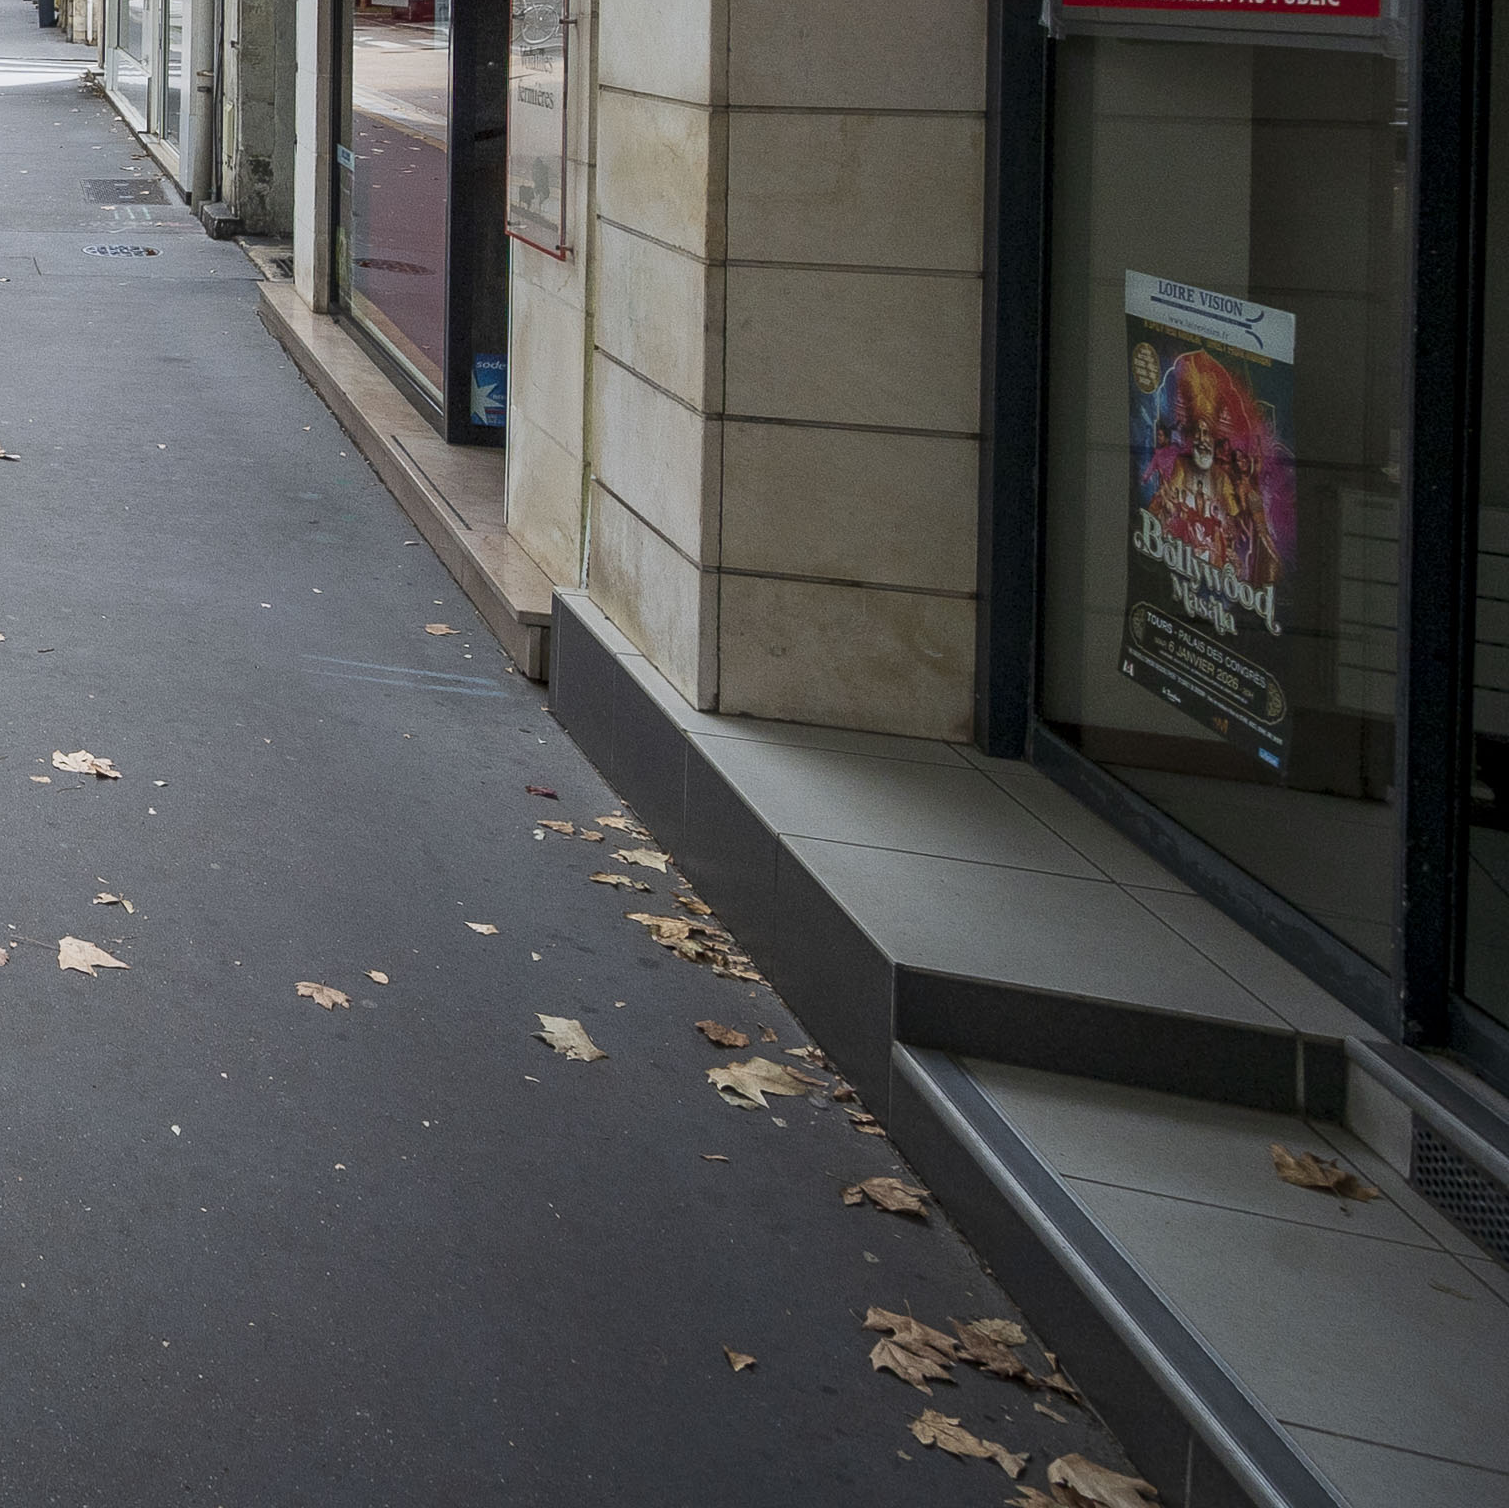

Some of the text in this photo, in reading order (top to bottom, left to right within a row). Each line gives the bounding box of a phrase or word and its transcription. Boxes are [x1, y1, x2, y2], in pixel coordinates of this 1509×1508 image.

[1158, 279, 1244, 317] LOIRE VISION
[1134, 508, 1282, 636] Bollywood
[1146, 611, 1173, 634] TOURS
[1178, 629, 1206, 653] PALAIS
[1206, 645, 1224, 664] DES
[1176, 647, 1215, 675] JANVIER
